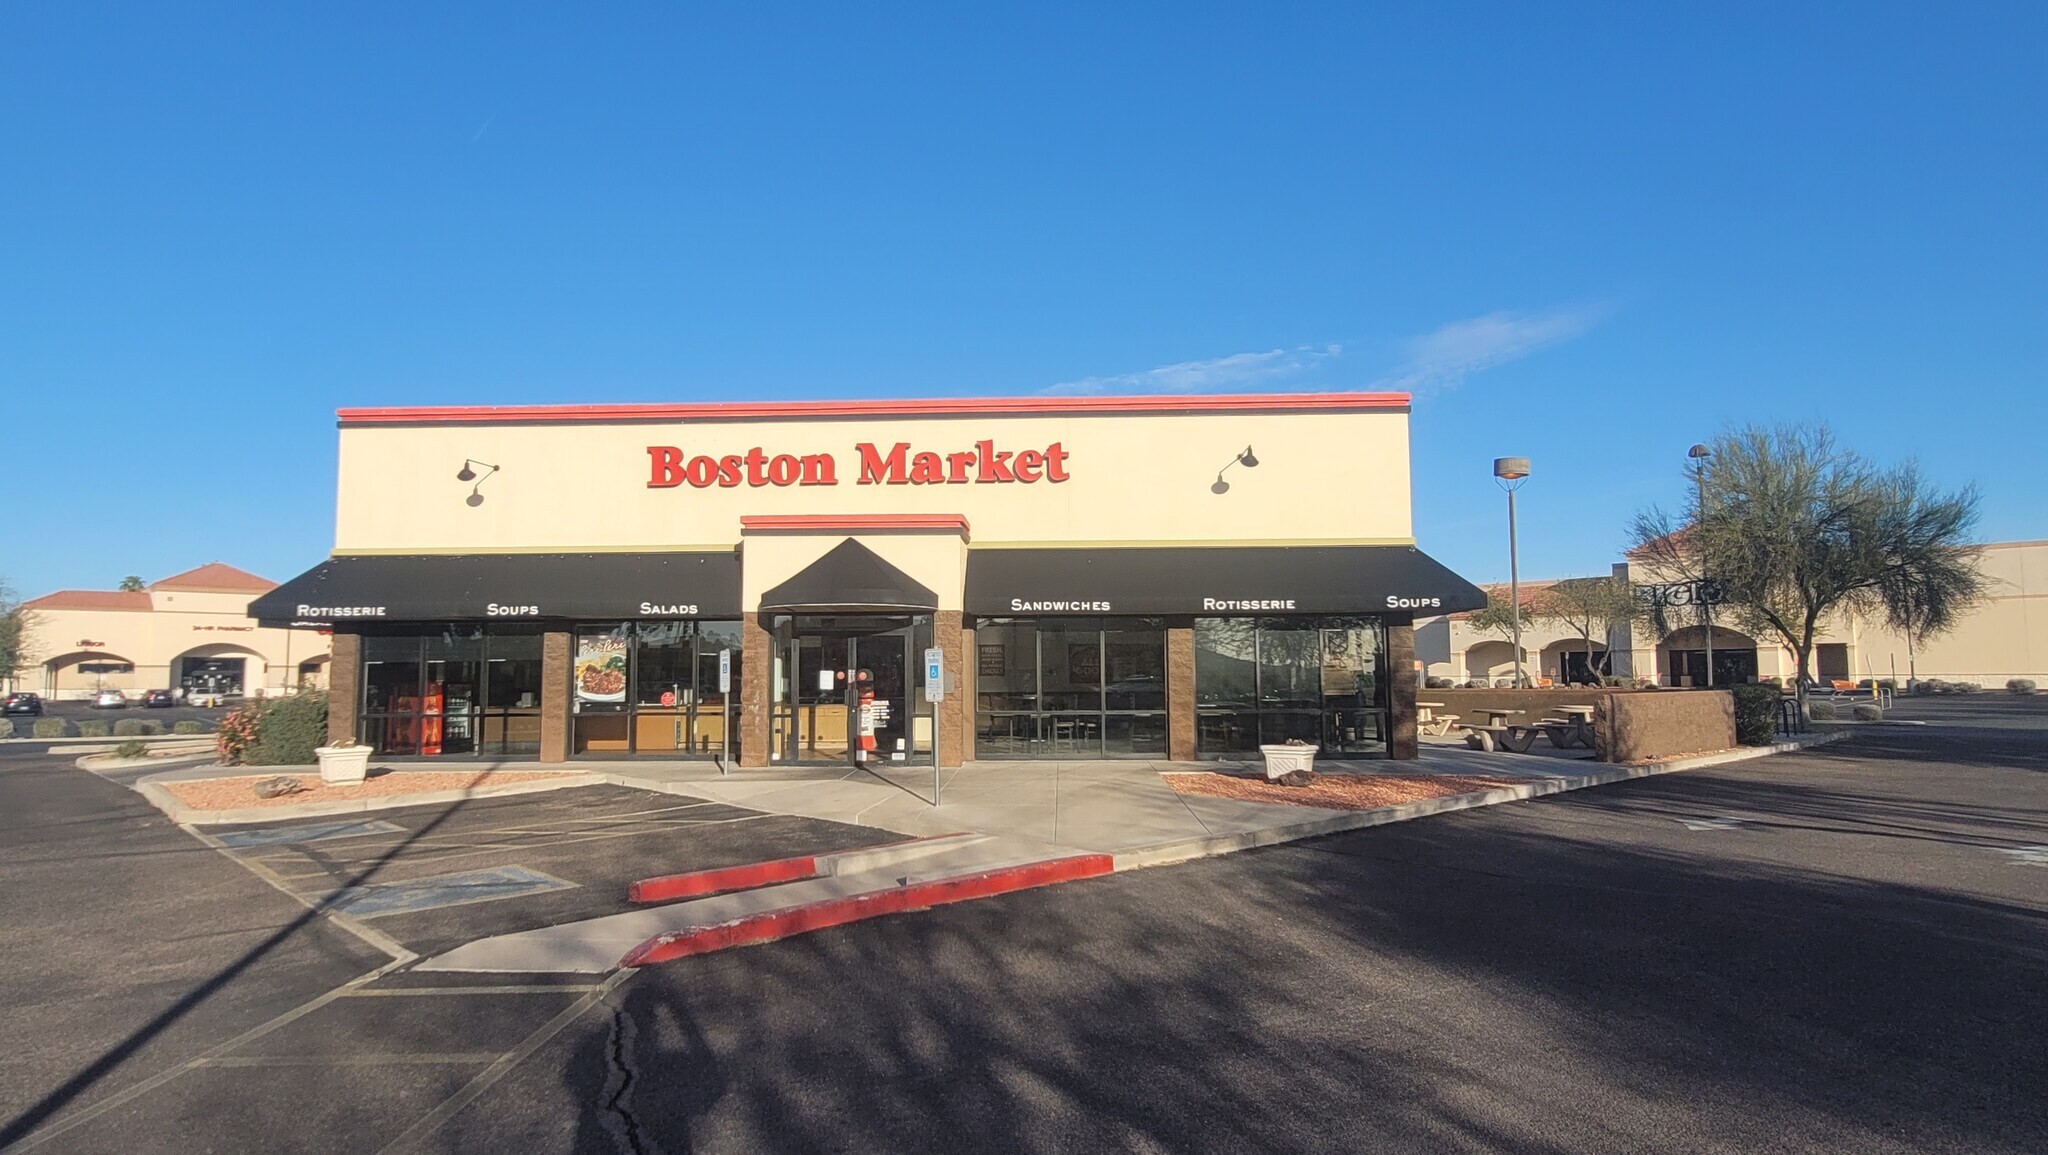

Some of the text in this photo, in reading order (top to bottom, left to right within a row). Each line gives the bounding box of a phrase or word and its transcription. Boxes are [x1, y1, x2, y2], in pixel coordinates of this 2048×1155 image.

[647, 438, 1071, 489] Boston Market
[640, 602, 699, 615] SALADS
[1010, 598, 1111, 611] SANDWICHES
[1203, 597, 1296, 611] ROTISSERIE
[1386, 595, 1441, 609] SOUPS
[296, 604, 386, 617] ROTISSERIE
[486, 603, 539, 616] SOUPS
